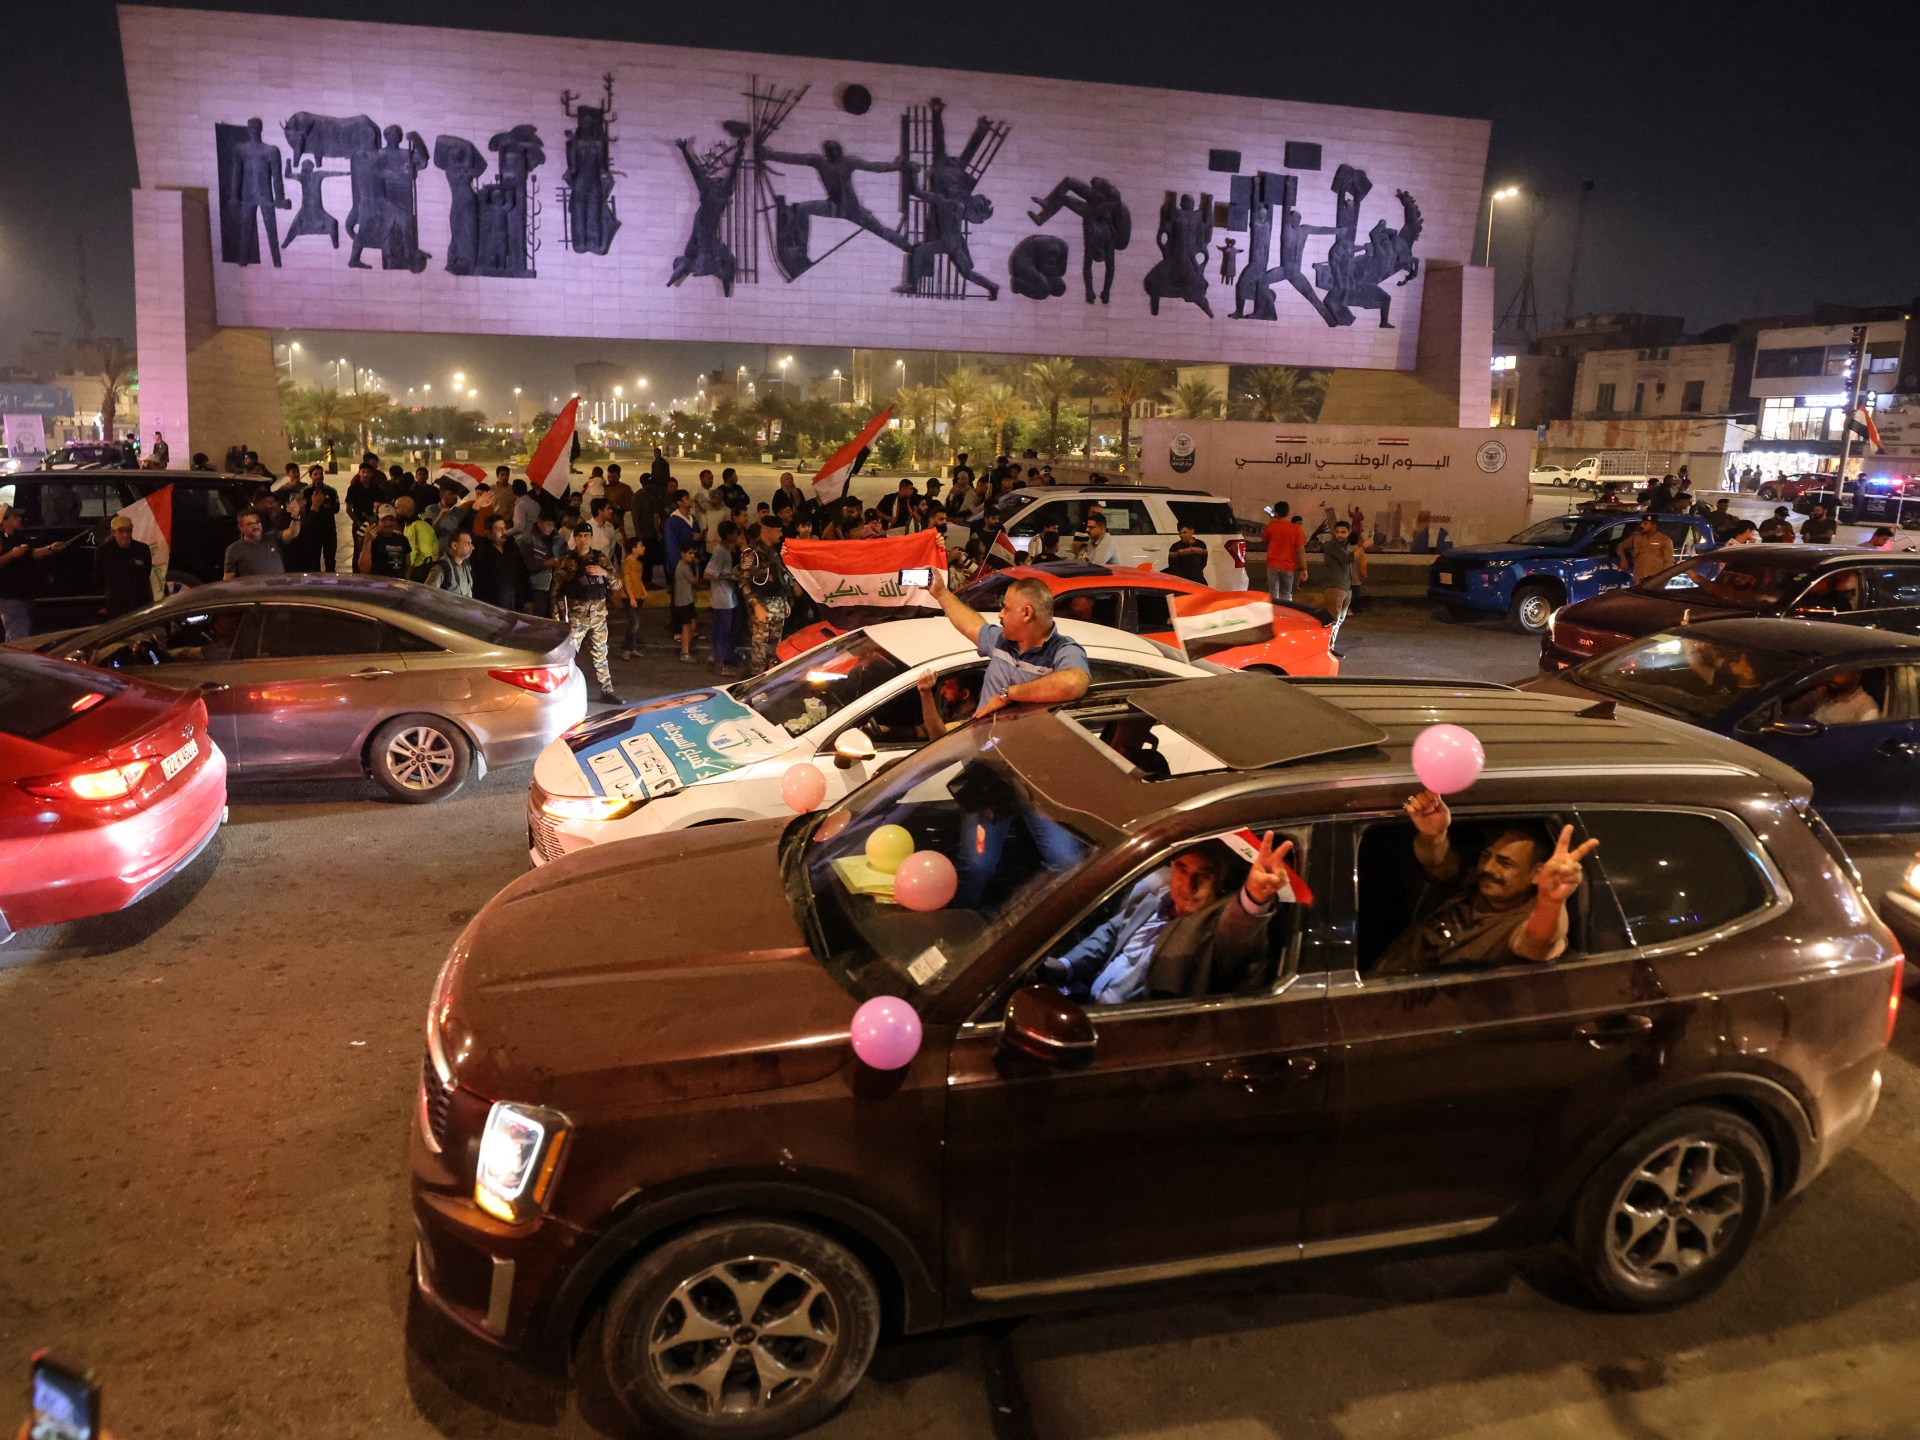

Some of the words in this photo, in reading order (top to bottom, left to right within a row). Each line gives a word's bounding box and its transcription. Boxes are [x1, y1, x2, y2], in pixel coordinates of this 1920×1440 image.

[1235, 452, 1311, 469] العراقي
[1315, 453, 1389, 471] الوطني
[1392, 455, 1450, 470] اليوم
[1319, 482, 1340, 492] مركز
[1342, 483, 1366, 492] بلدية
[878, 578, 906, 597] الله
[656, 722, 697, 749] السوداني
